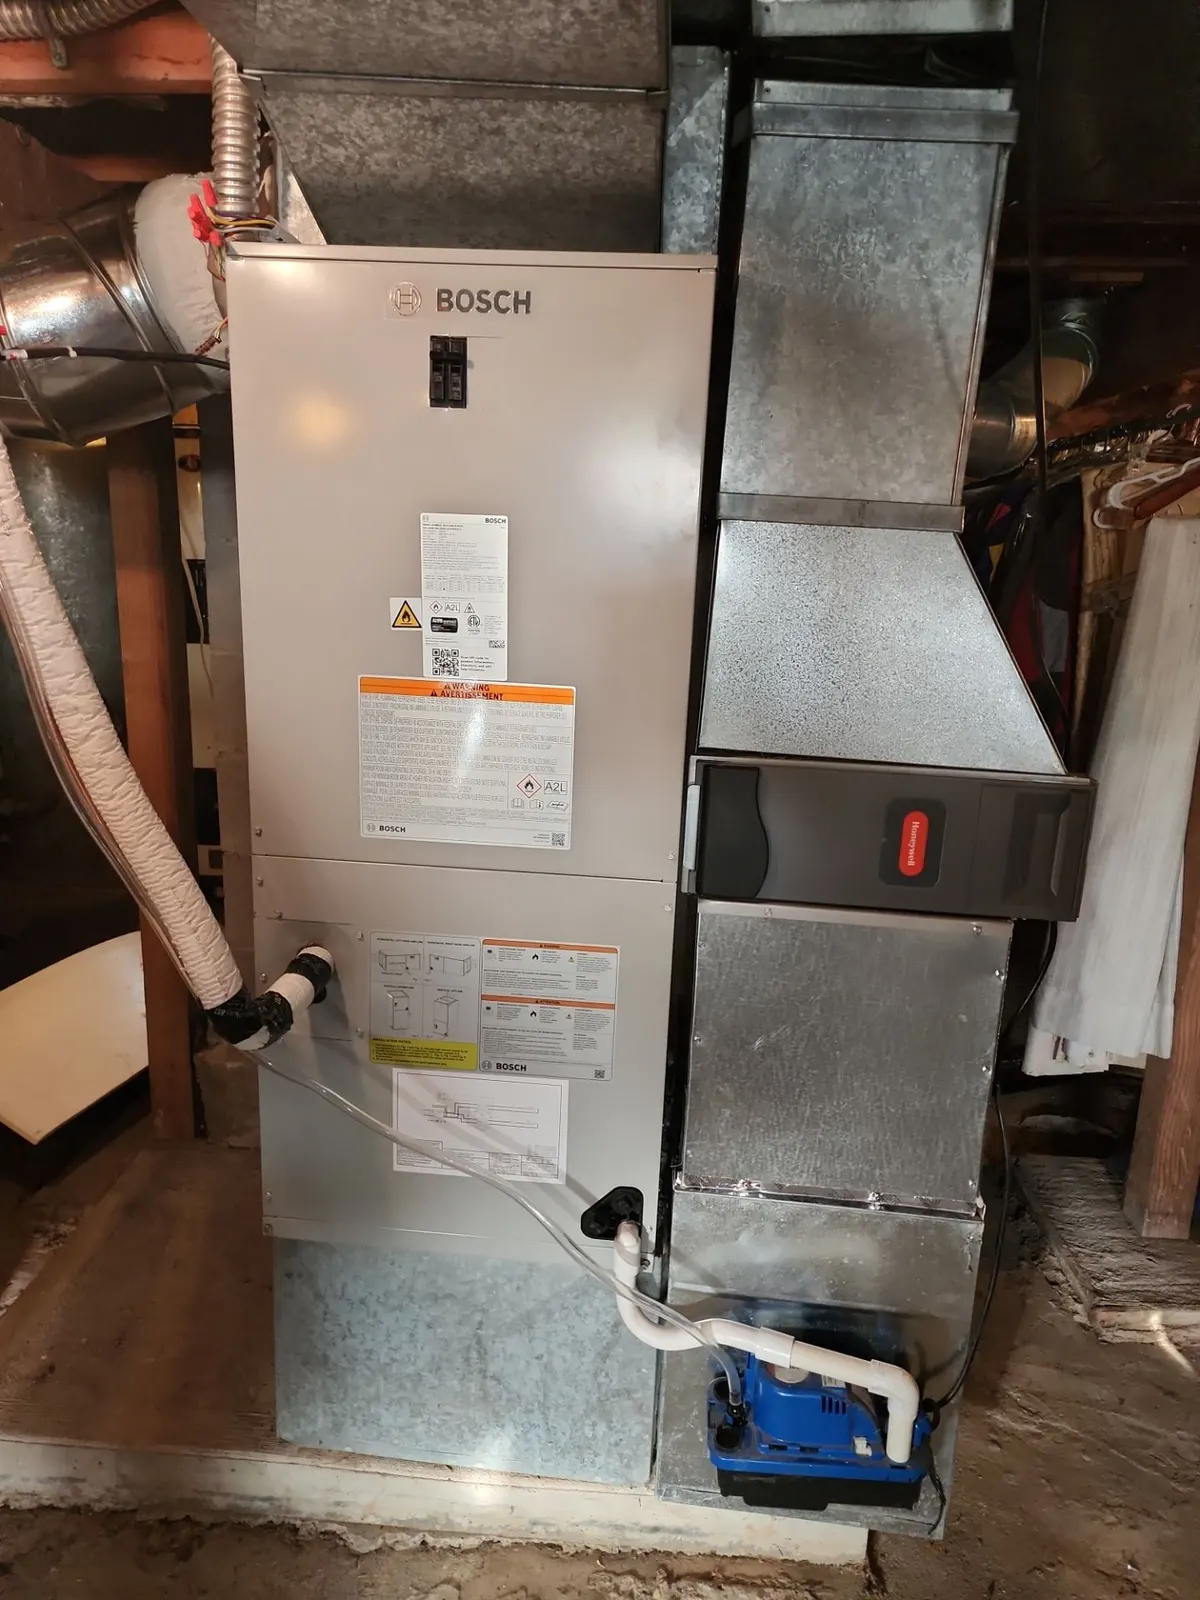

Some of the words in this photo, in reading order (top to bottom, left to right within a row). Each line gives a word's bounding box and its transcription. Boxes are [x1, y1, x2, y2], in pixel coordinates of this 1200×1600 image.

[436, 288, 532, 314] BOSCH
[545, 782, 567, 793] A2L
[379, 824, 406, 834] BOSCH
[907, 821, 920, 866] Honeywell
[496, 1062, 527, 1072] BOSCH
